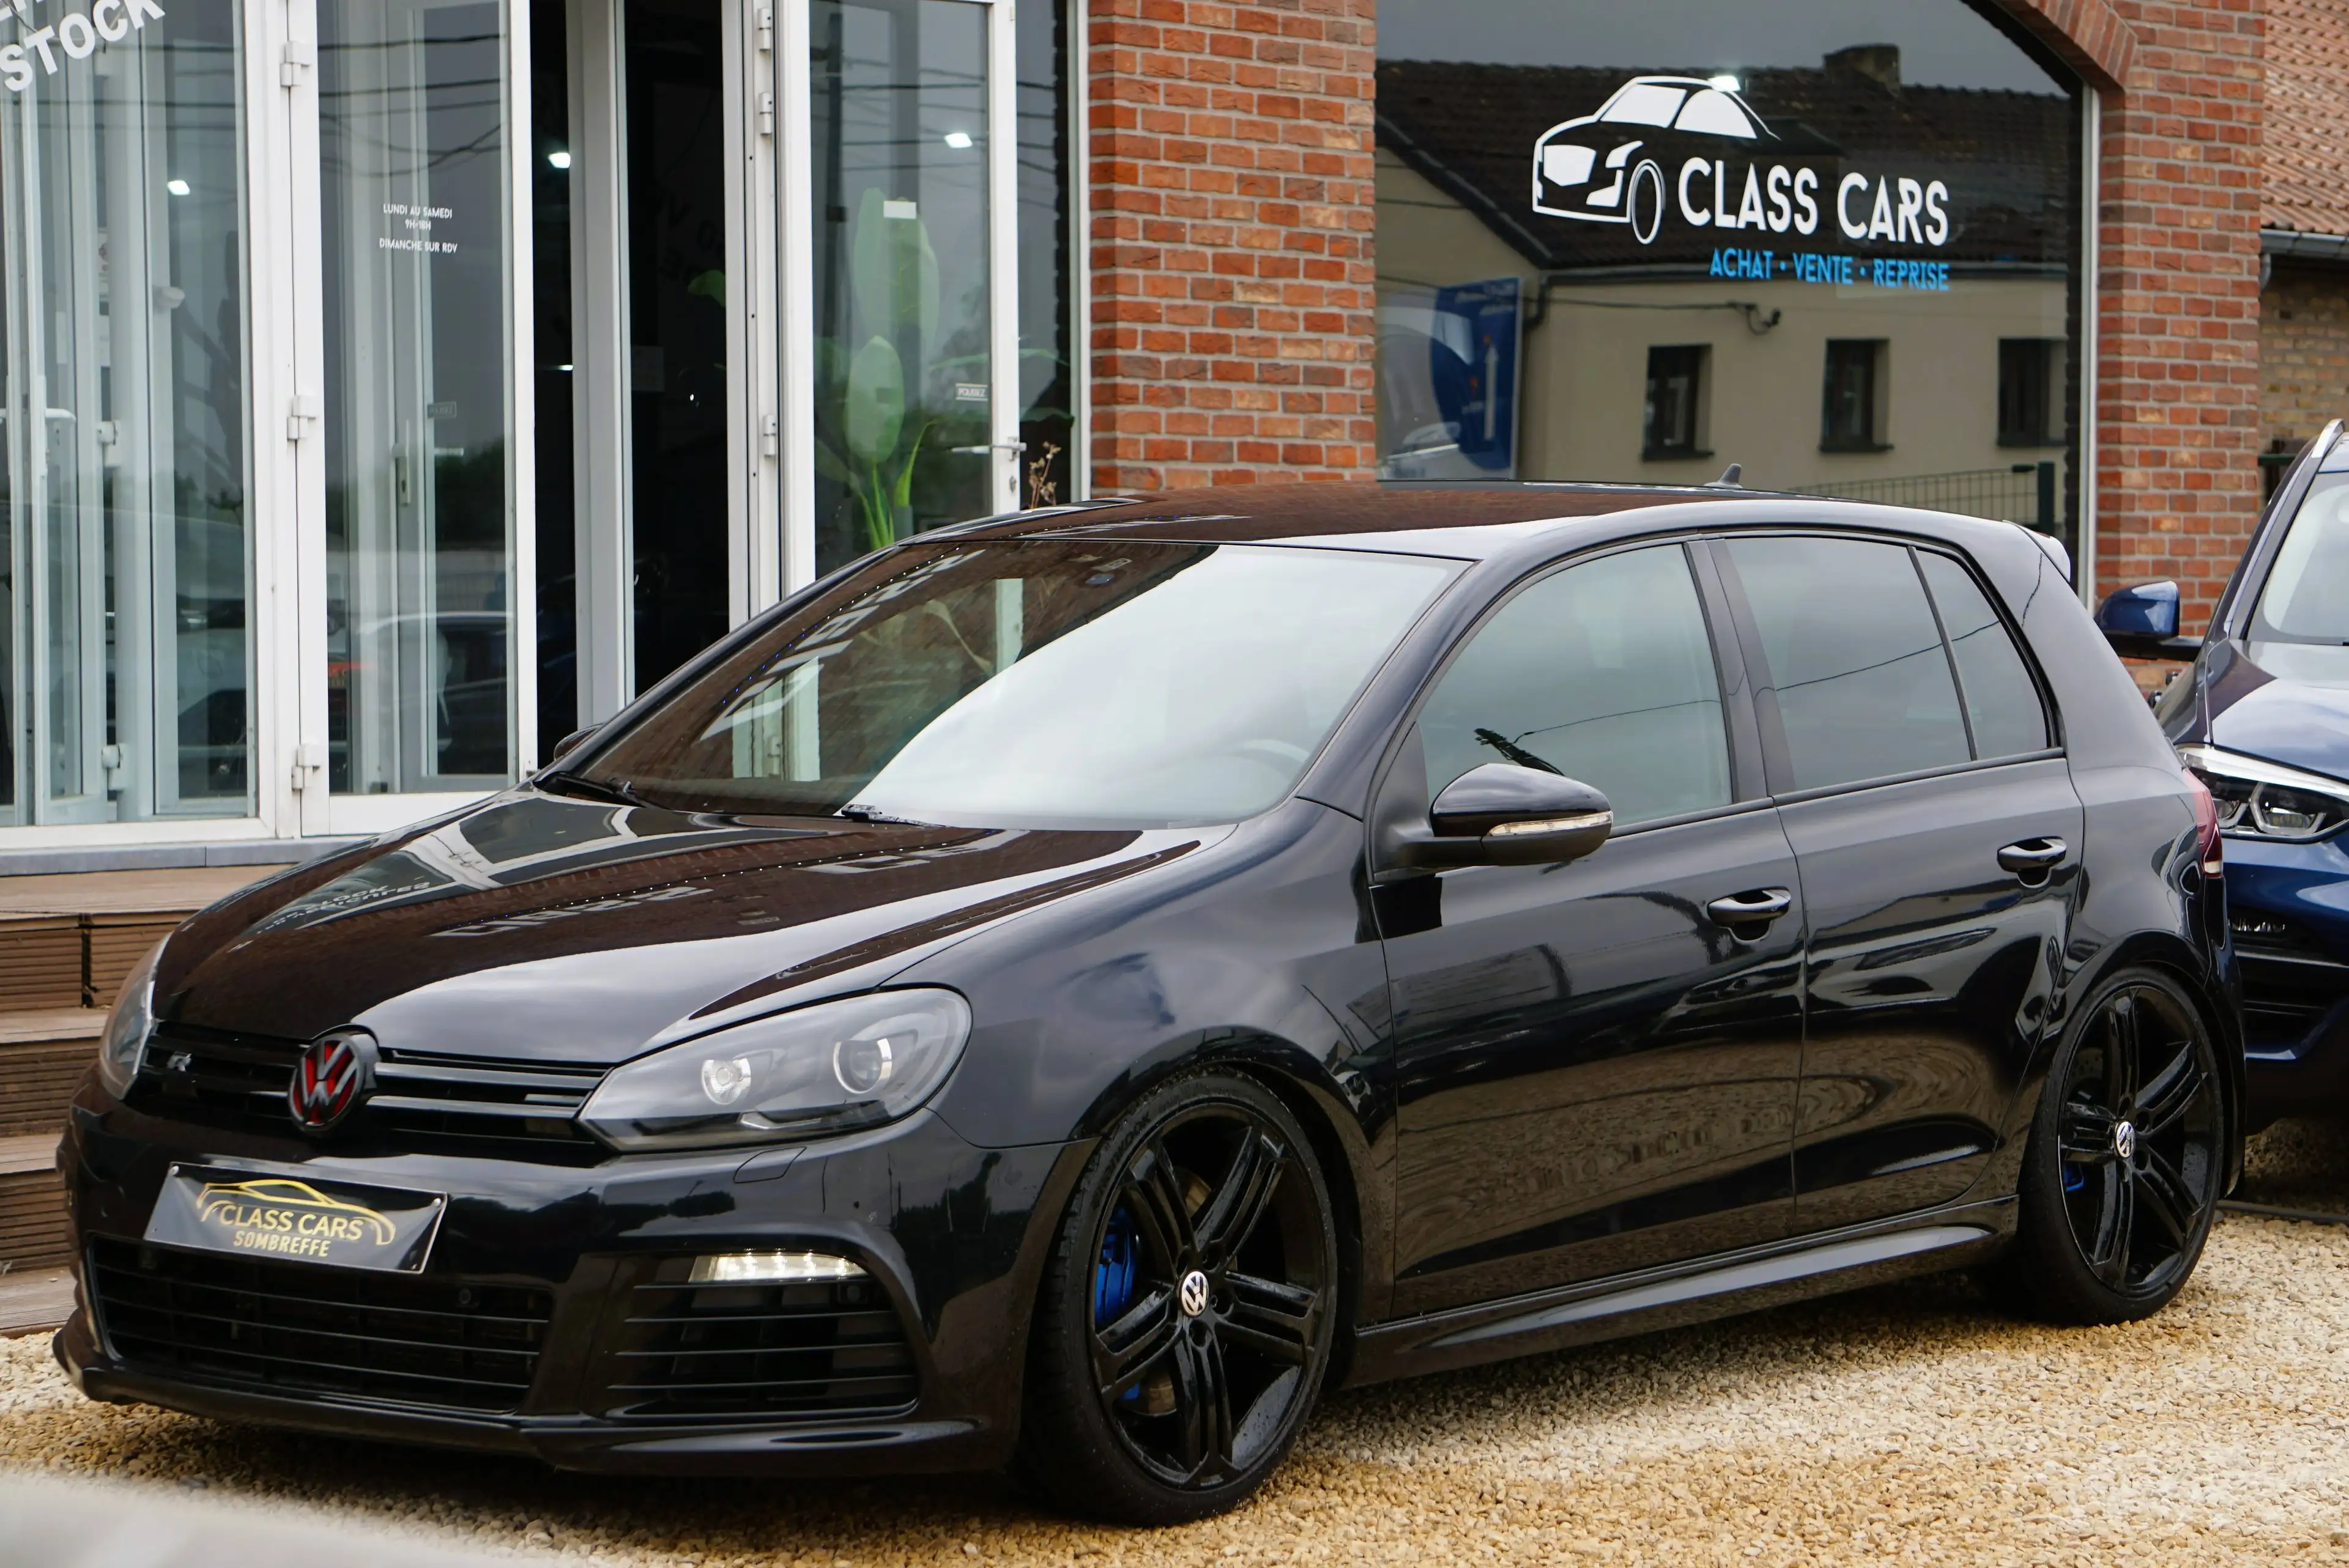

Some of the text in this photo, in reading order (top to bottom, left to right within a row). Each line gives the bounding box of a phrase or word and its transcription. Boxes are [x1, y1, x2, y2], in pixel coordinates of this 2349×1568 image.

[0, 0, 165, 91] STOCK
[384, 203, 453, 219] LUNDI AU SAMEDI
[1678, 157, 1949, 246] CLASS CARS
[379, 238, 458, 254] DIMANCHE SUR RDV
[1710, 248, 1950, 291] ACHAT VENTE REPRISE
[220, 1204, 364, 1240] CLASS CARS
[233, 1230, 331, 1257] SOMBREFFE
